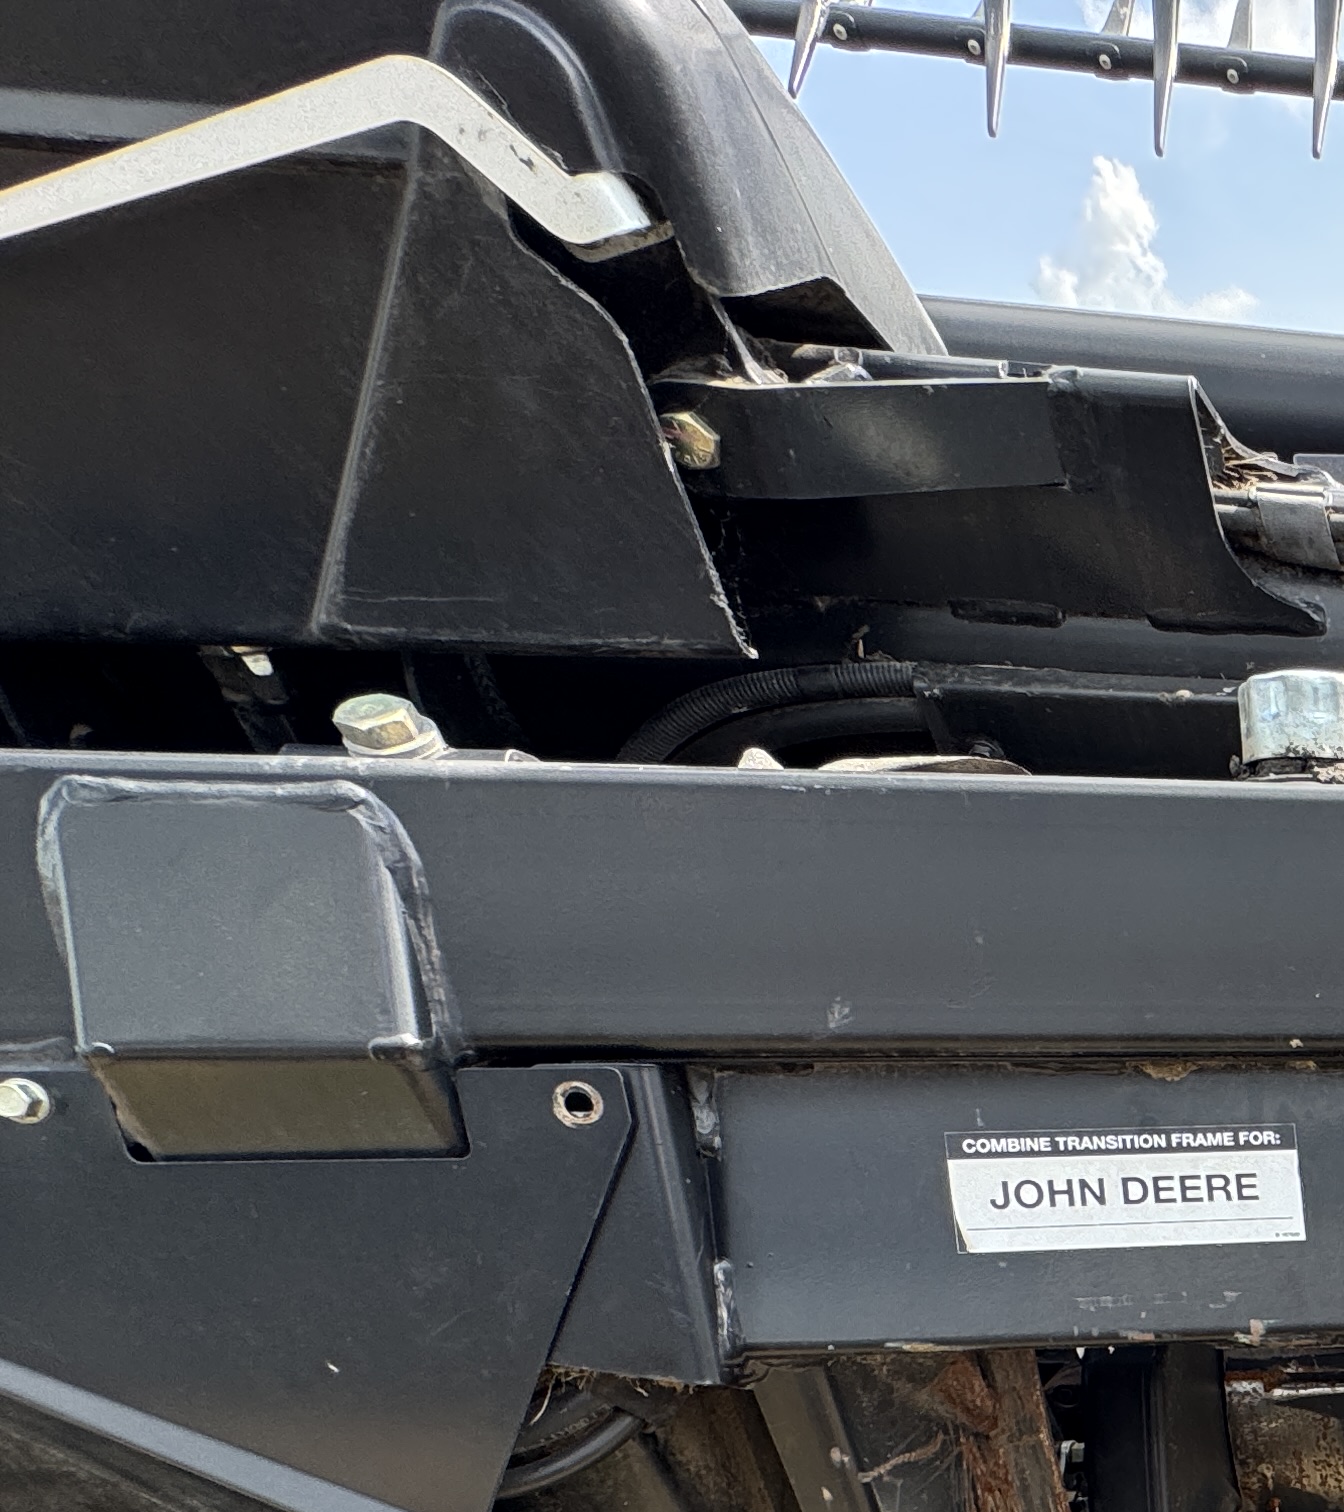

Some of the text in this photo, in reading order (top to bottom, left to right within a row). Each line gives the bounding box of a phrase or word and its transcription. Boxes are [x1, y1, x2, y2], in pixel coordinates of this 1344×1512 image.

[962, 1130, 1282, 1154] COMBINE TRANSITION FRAME FOR:
[989, 1172, 1260, 1210] JOHN DEERE
